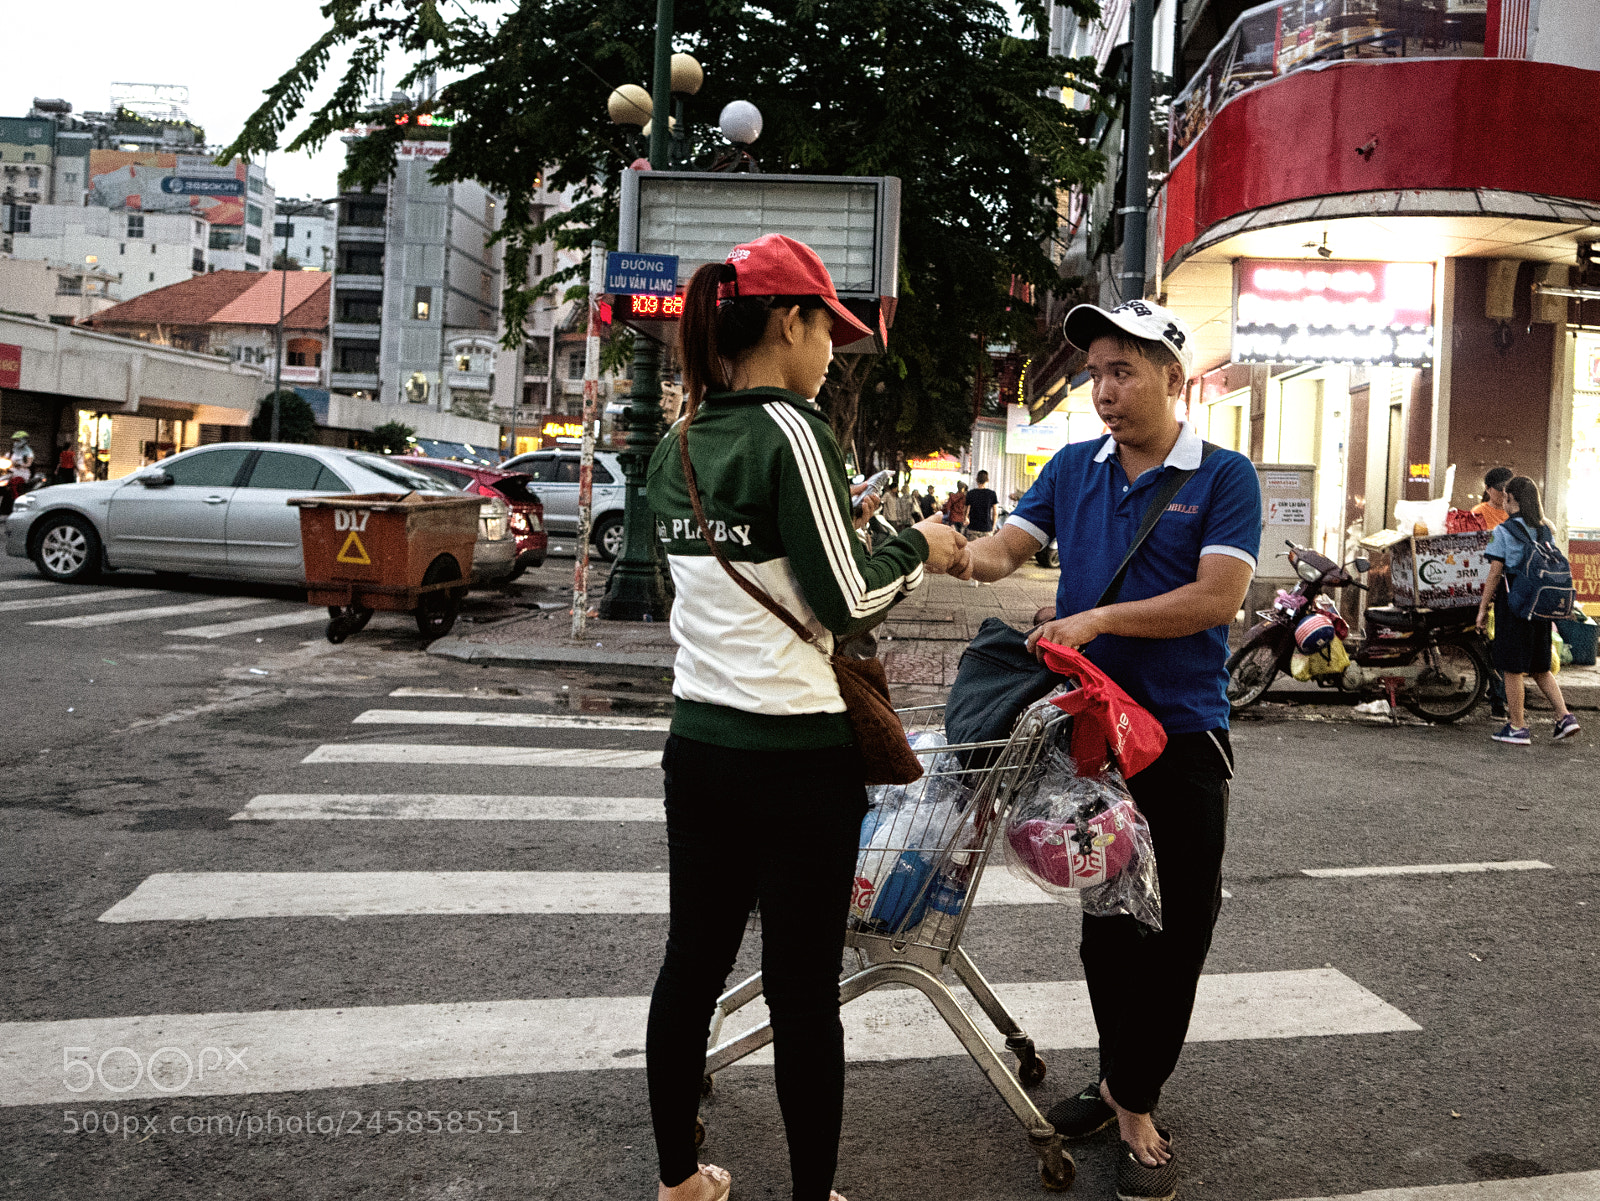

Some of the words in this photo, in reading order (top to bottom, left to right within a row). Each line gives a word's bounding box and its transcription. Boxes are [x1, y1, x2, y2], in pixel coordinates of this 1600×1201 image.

[649, 278, 673, 292] LANG
[1163, 322, 1186, 351] 22
[334, 509, 371, 532] D17
